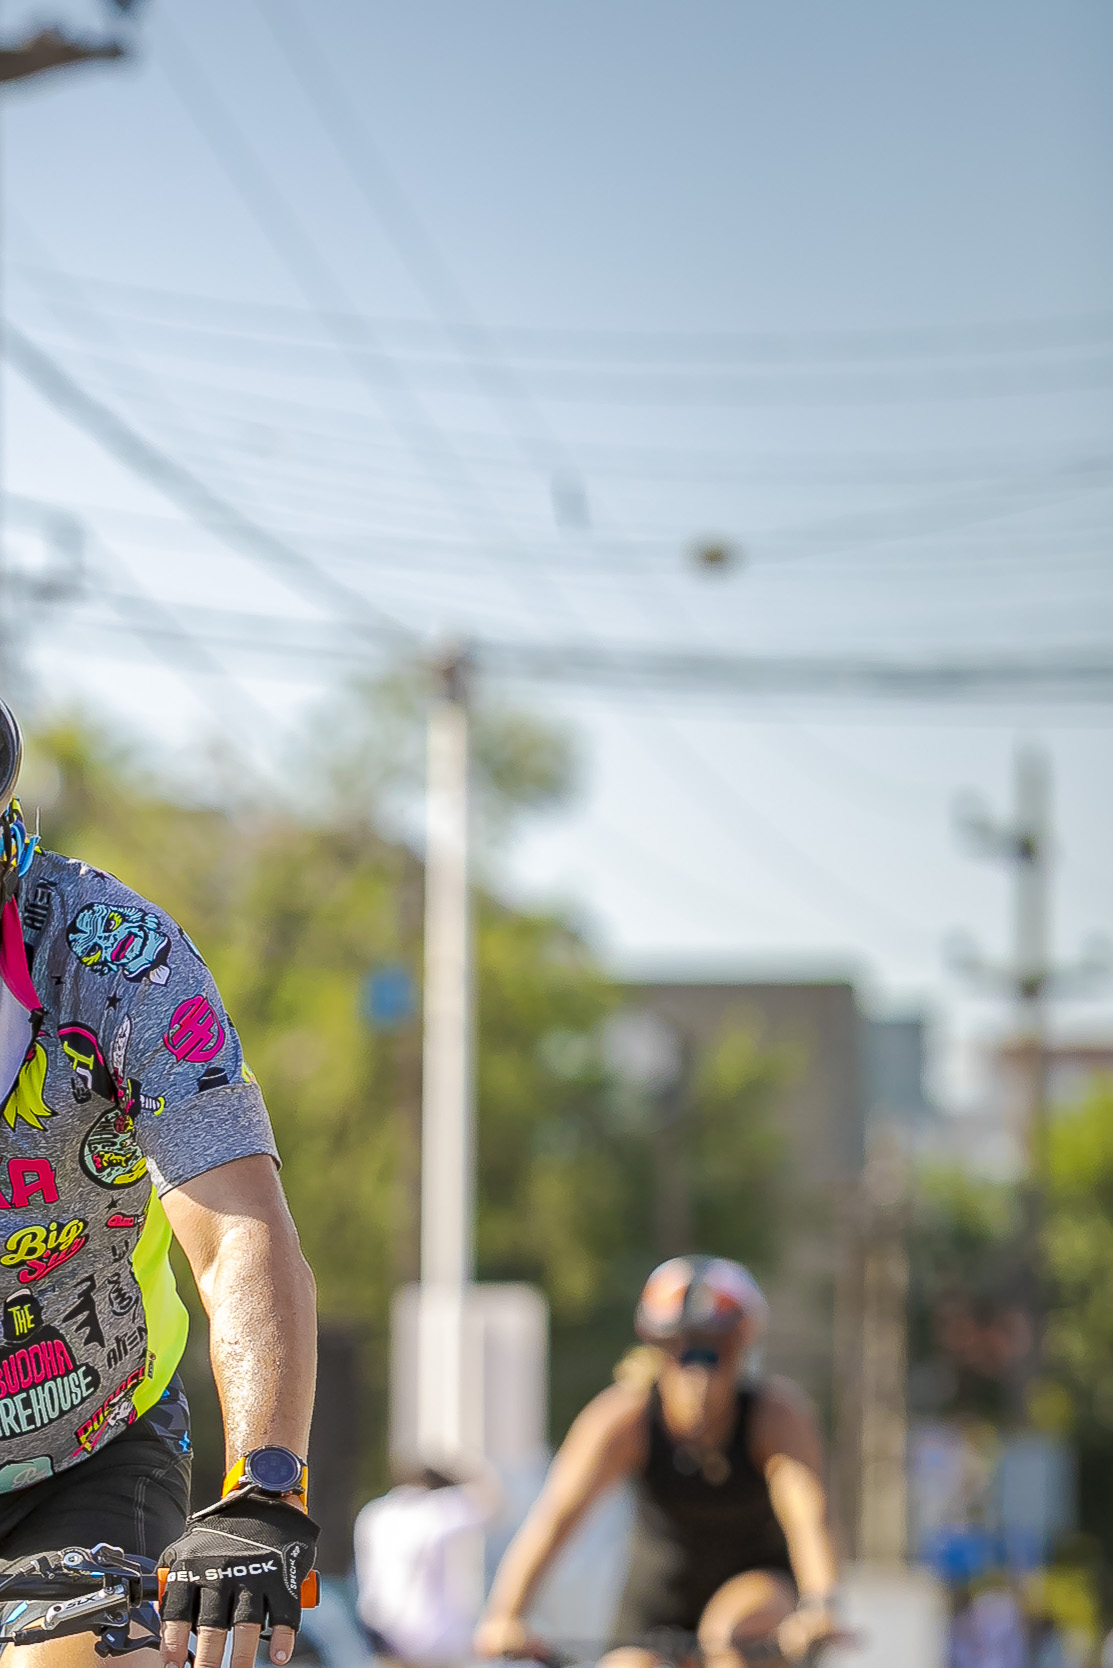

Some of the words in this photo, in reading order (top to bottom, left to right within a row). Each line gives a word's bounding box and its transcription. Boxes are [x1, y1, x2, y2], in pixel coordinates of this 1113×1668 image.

[0, 1219, 85, 1267] Big
[7, 1304, 36, 1336] THE
[167, 1570, 200, 1583] GEL
[205, 1559, 278, 1581] SHOCK
[65, 1595, 96, 1610] SLX
